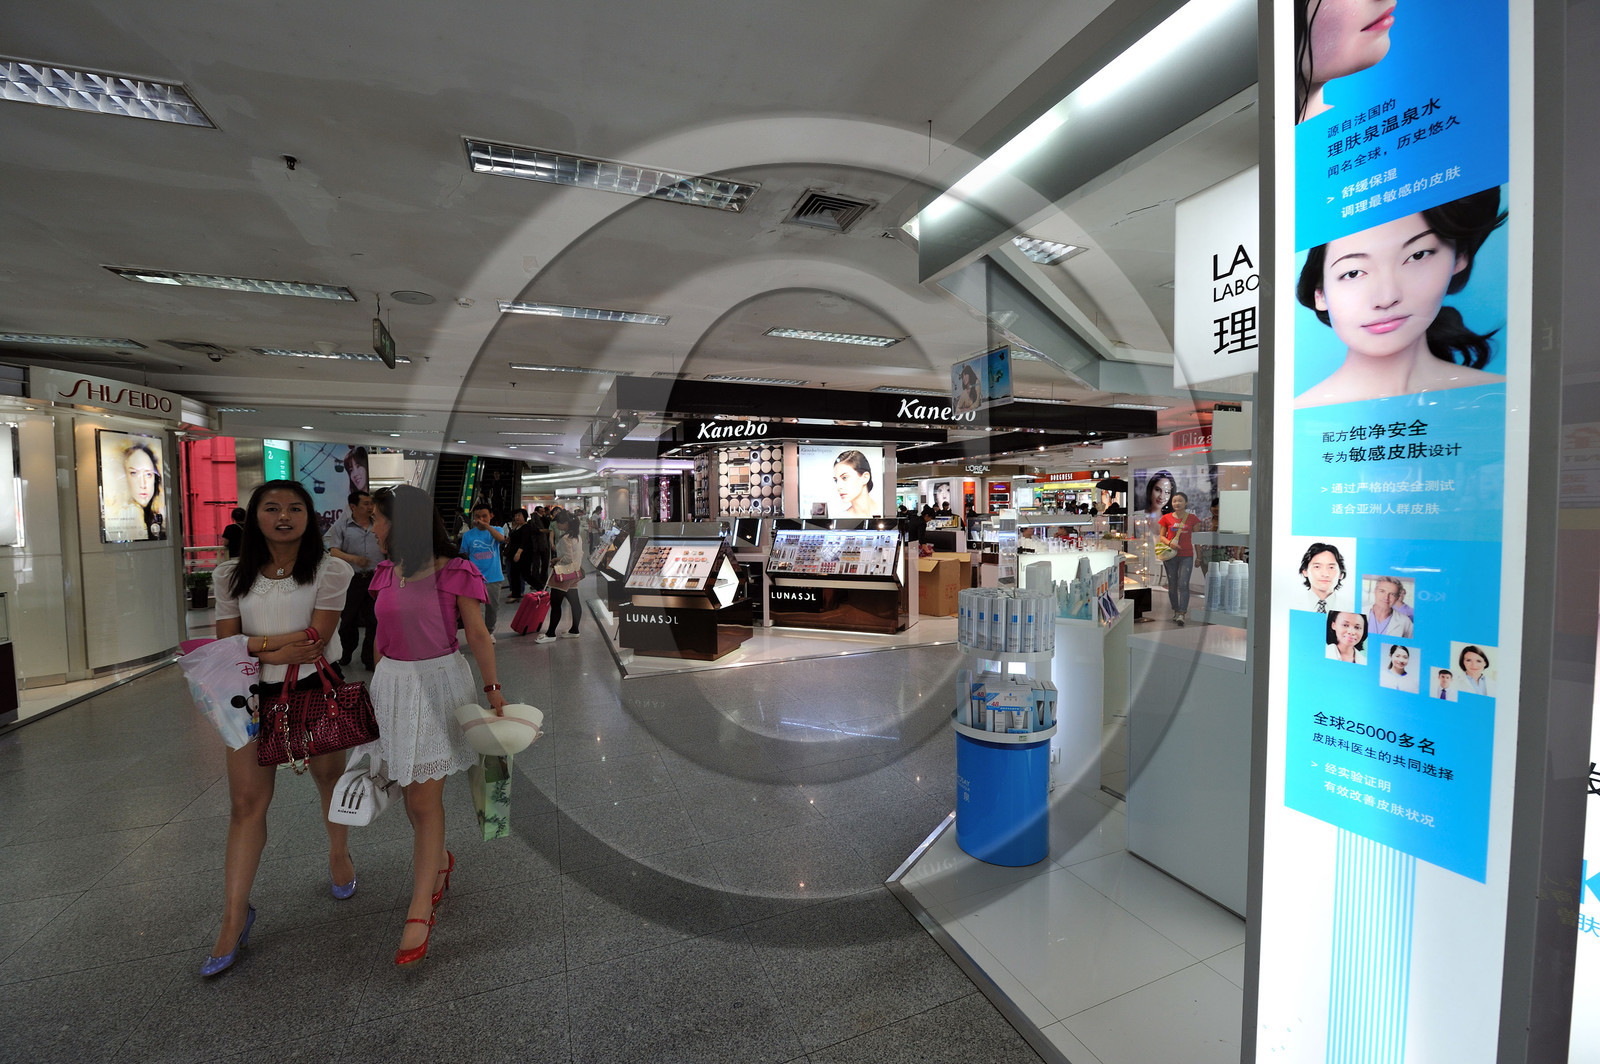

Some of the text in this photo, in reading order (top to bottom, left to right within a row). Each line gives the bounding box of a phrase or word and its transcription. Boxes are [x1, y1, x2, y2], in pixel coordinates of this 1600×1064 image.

[1327, 97, 1441, 158] 理肤泉温泉水
[1328, 98, 1396, 139] 源自法国的
[1341, 167, 1398, 199] 舒缓保湿
[1341, 165, 1461, 218] 调理最敏感的皮肤
[1213, 244, 1254, 281] LA
[1213, 274, 1260, 303] LABO
[1213, 306, 1259, 355] 理
[58, 379, 172, 412] SHISEIDO
[697, 420, 768, 439] Kanebo
[1322, 419, 1428, 443] 配方纯净安全
[1322, 442, 1462, 463] 专为敏感皮肤设计
[1331, 479, 1455, 494] 通过严格的安全测试
[722, 505, 779, 514] LUNASOL
[1332, 503, 1440, 515] 适合亚洲人群皮肤
[771, 592, 817, 601] LUNASOL
[626, 613, 679, 625] LUNASOL
[1313, 711, 1436, 756] 全球25000多名
[1312, 732, 1455, 781] 皮肤科医生的共同选择
[1325, 762, 1392, 793] 经实验证明
[1324, 781, 1435, 828] 有效改善皮肤状况
